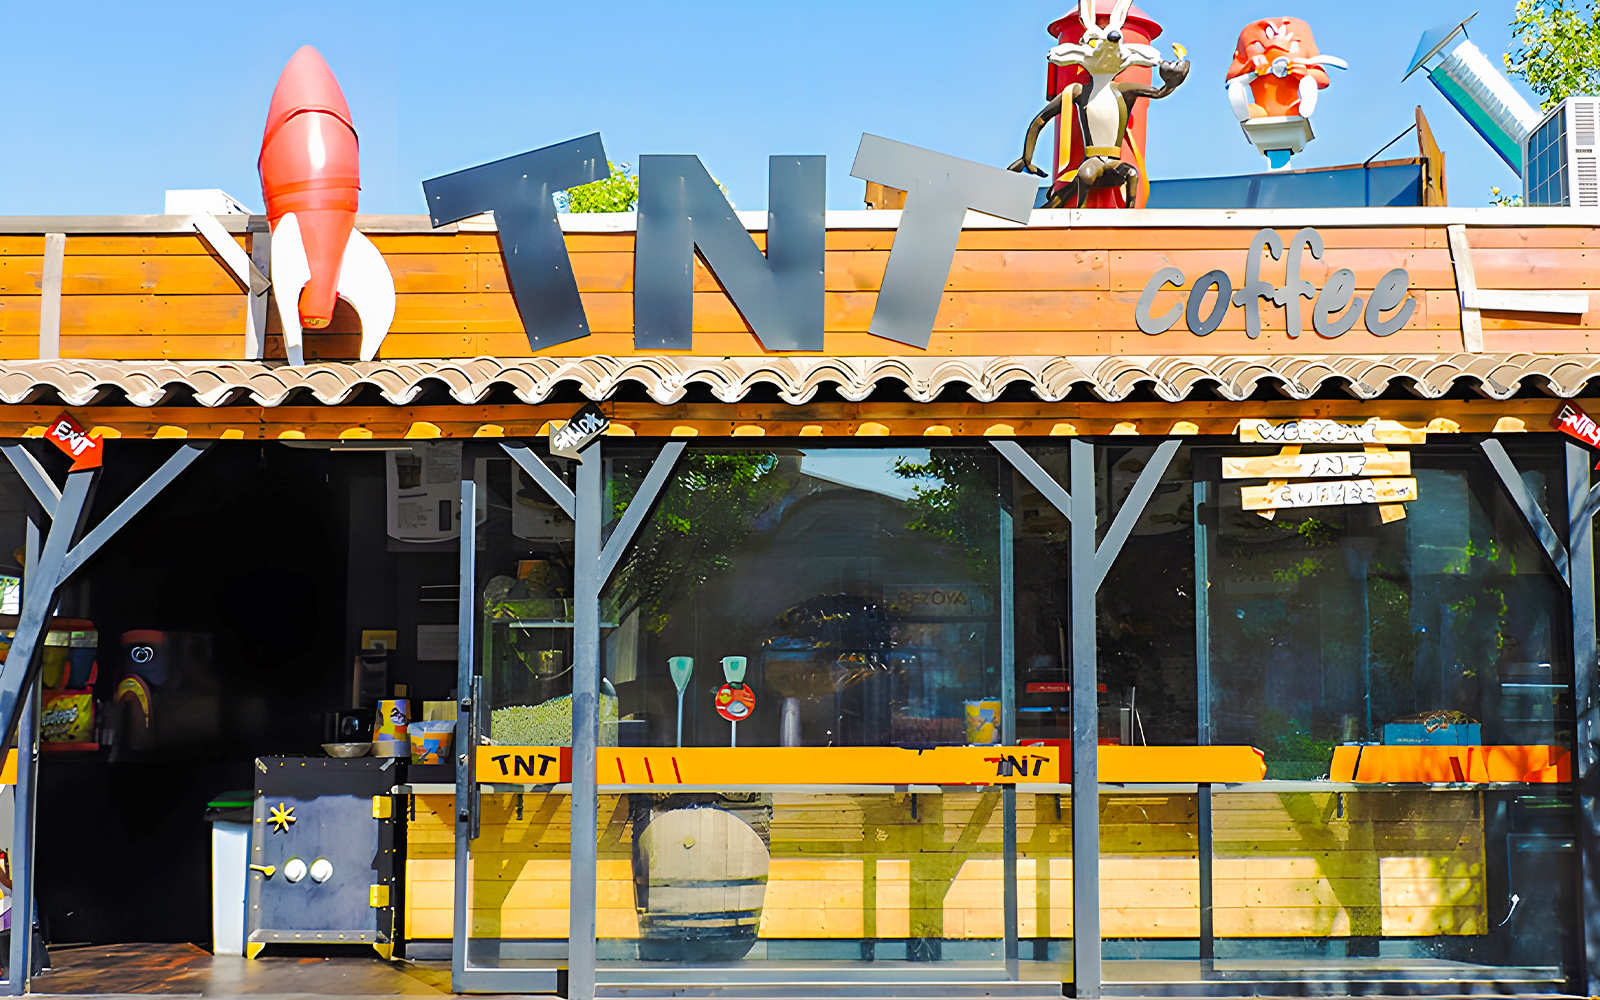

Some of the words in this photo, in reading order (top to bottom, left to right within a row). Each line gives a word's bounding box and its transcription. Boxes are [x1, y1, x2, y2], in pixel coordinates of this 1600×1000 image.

[422, 132, 1041, 352] TNT
[1135, 227, 1416, 339] coffee
[491, 754, 557, 776] TNT
[983, 754, 1050, 777] TNT
